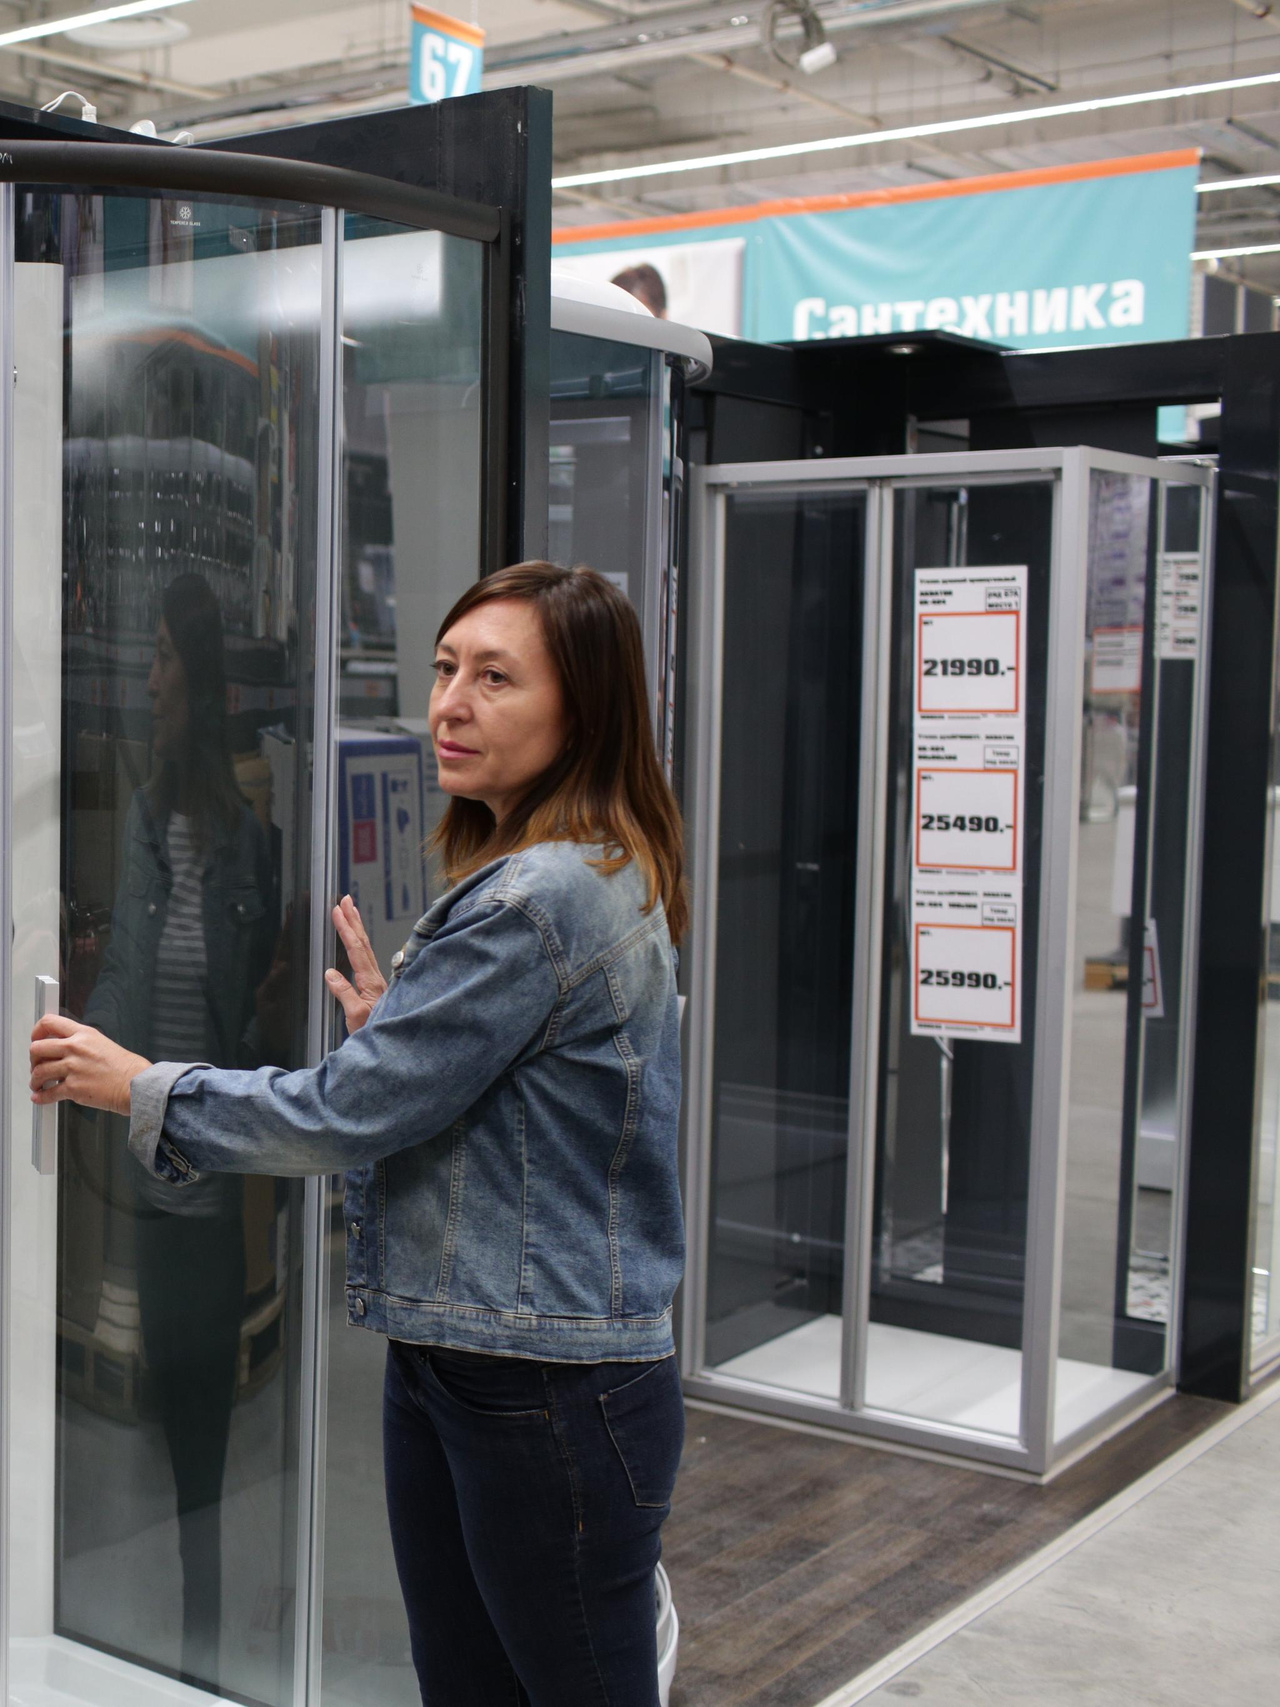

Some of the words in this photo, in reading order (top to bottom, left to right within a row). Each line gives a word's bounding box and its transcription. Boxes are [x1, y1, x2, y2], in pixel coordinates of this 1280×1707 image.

[420, 32, 473, 102] 67
[793, 278, 1145, 342] Сантехника
[923, 658, 1016, 677] 21990.-
[921, 814, 1014, 833] 25490.-
[920, 968, 1012, 990] 25990.-
